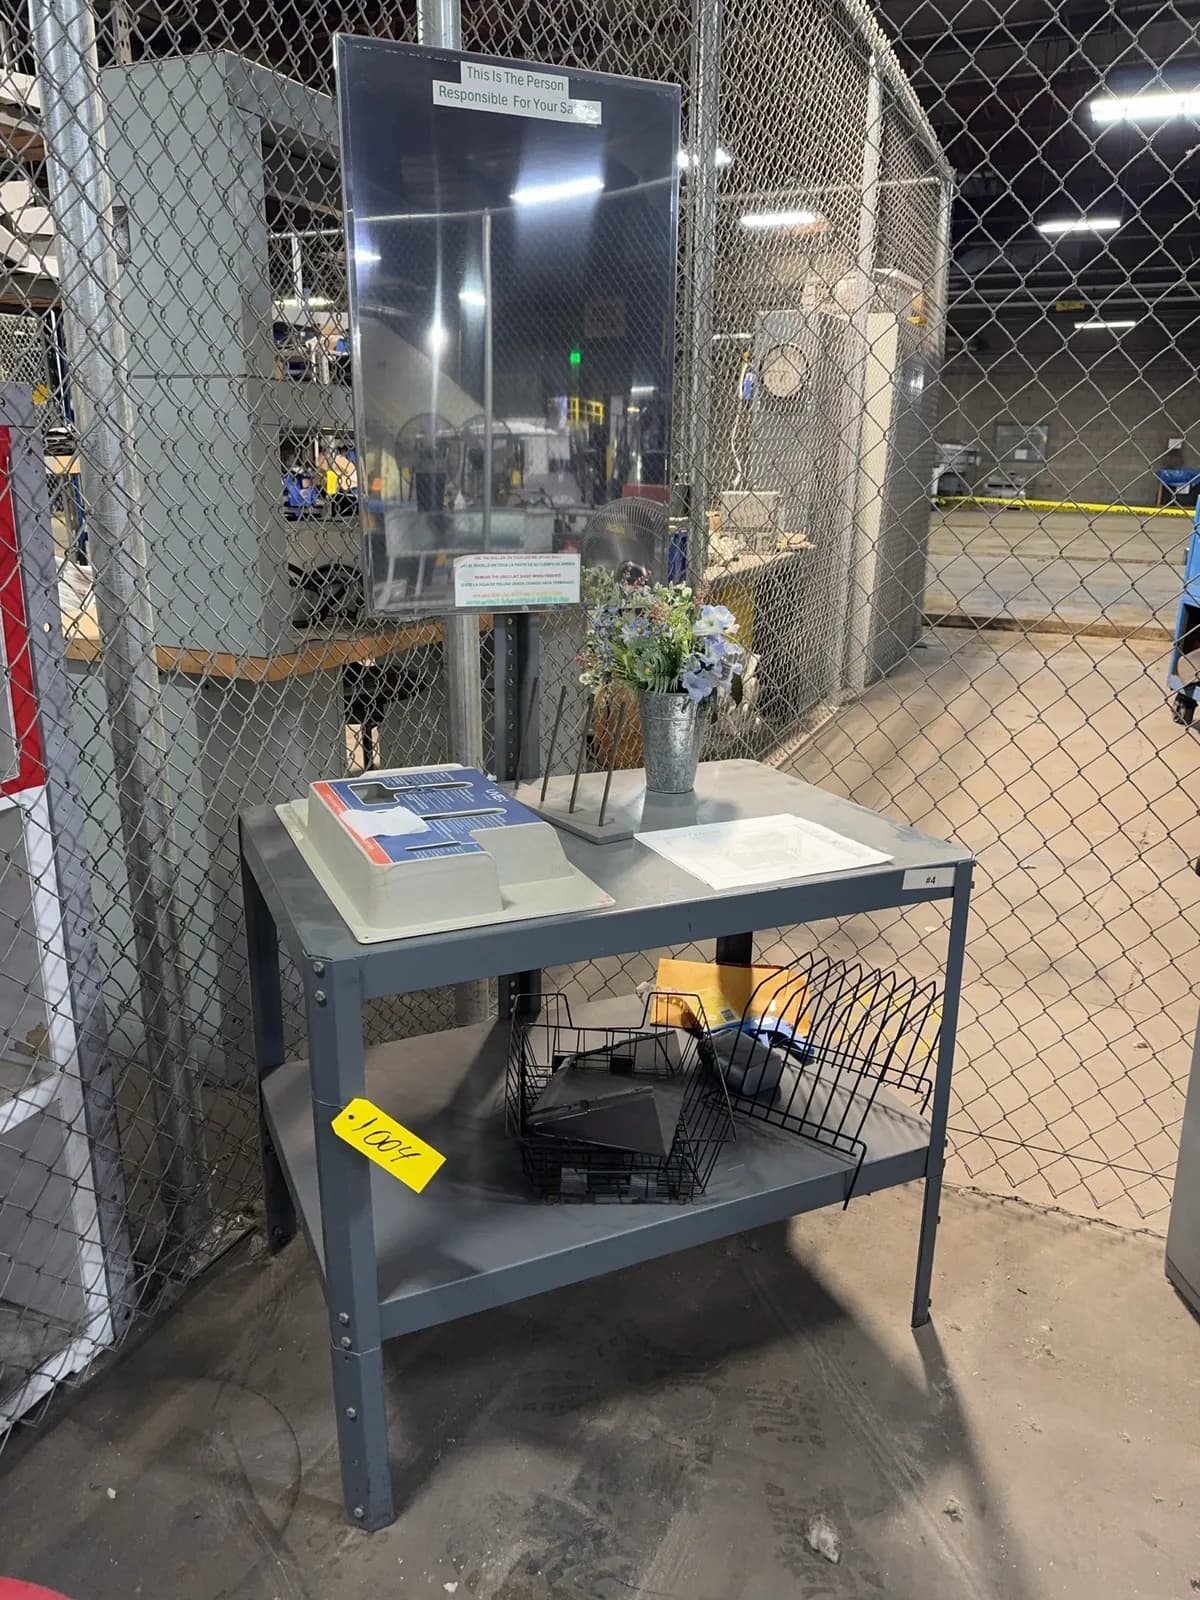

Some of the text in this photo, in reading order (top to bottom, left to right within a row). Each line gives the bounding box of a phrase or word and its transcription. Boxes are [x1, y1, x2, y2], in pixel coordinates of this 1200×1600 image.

[466, 65, 564, 92] This Is The Person
[439, 85, 508, 106] Responsible
[513, 96, 531, 109] For
[533, 98, 558, 112] Your
[925, 876, 936, 884] #4
[351, 1117, 422, 1162] 1004
